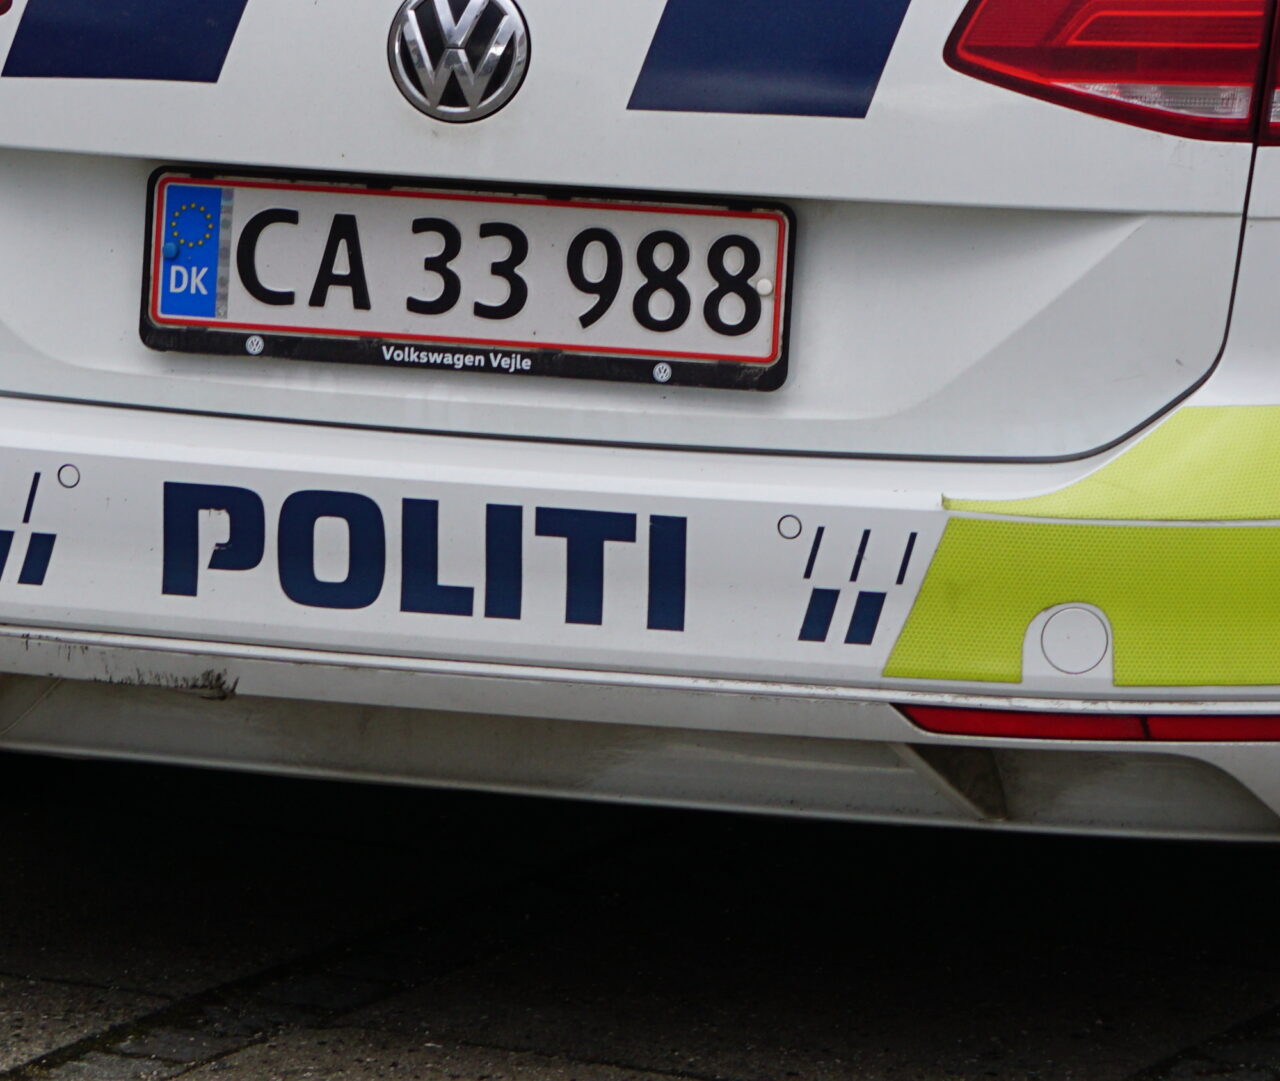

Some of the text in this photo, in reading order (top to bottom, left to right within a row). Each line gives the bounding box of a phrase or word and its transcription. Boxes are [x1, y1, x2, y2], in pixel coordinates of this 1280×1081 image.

[169, 265, 208, 295] DK
[236, 207, 761, 337] CA 33 988
[381, 345, 532, 373] Volkswagen Vejle
[162, 481, 688, 632] POLITI
